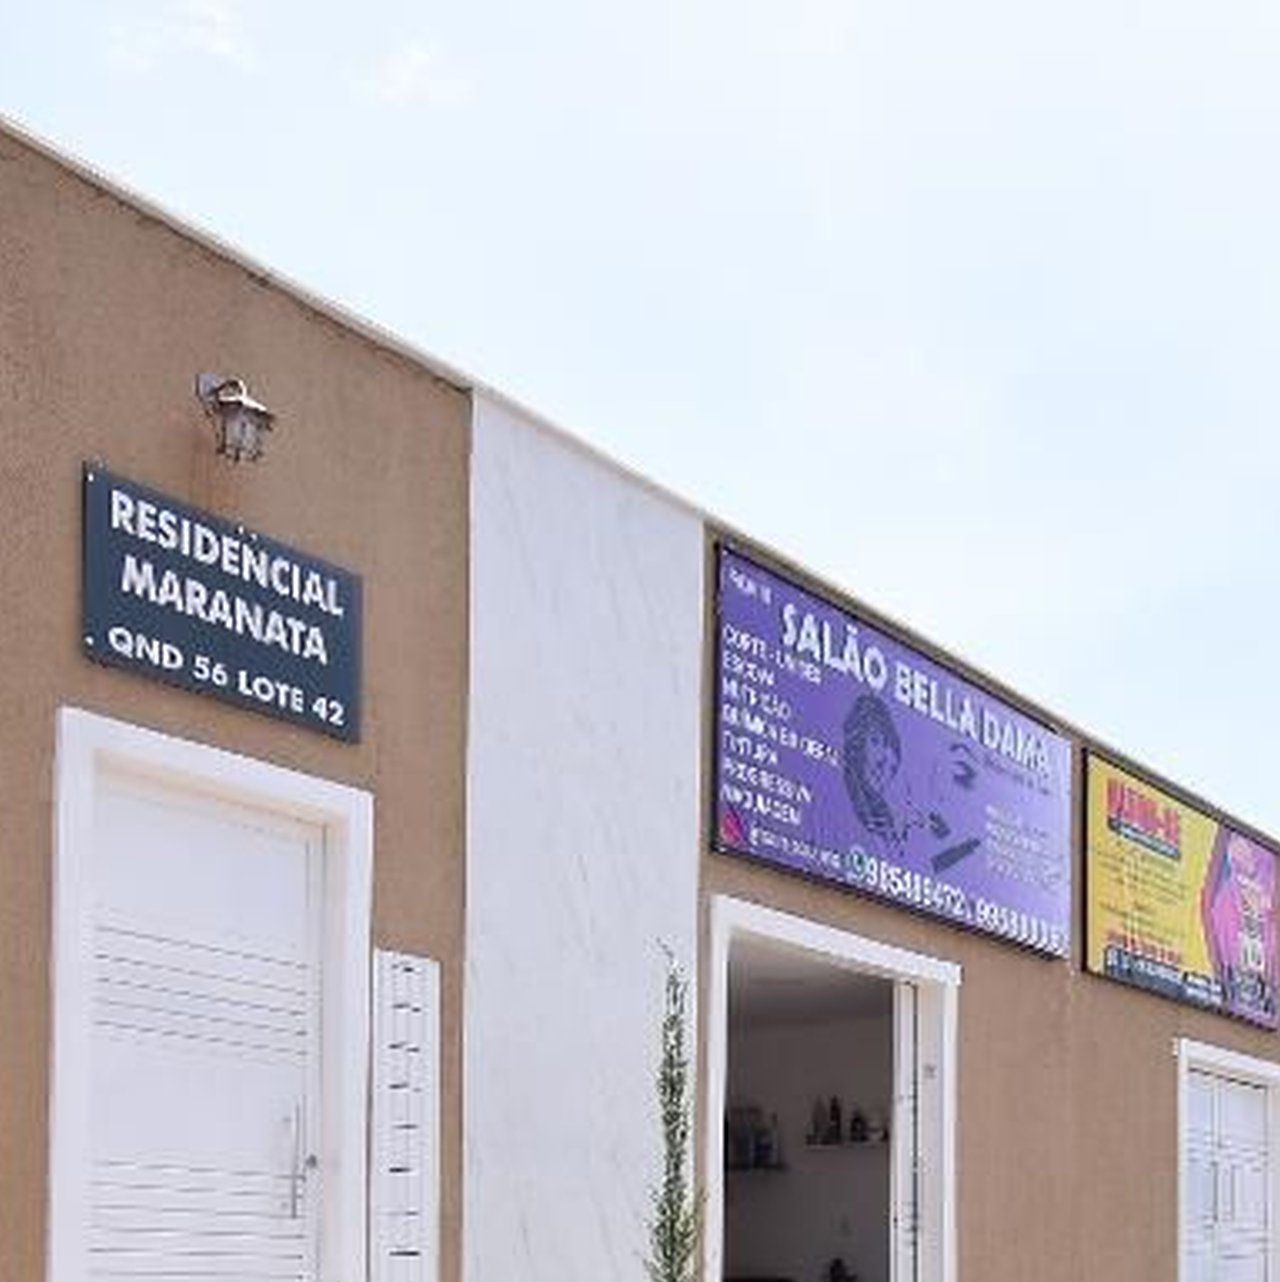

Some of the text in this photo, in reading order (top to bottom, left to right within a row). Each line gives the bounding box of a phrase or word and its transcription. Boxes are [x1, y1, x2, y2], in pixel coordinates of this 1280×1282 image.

[110, 489, 345, 617] RESIDENCIAL
[121, 554, 328, 666] MARANATA
[107, 625, 346, 727] QND 56 LOTE 42
[782, 603, 889, 690] SALÃO
[894, 660, 980, 741] BELLA
